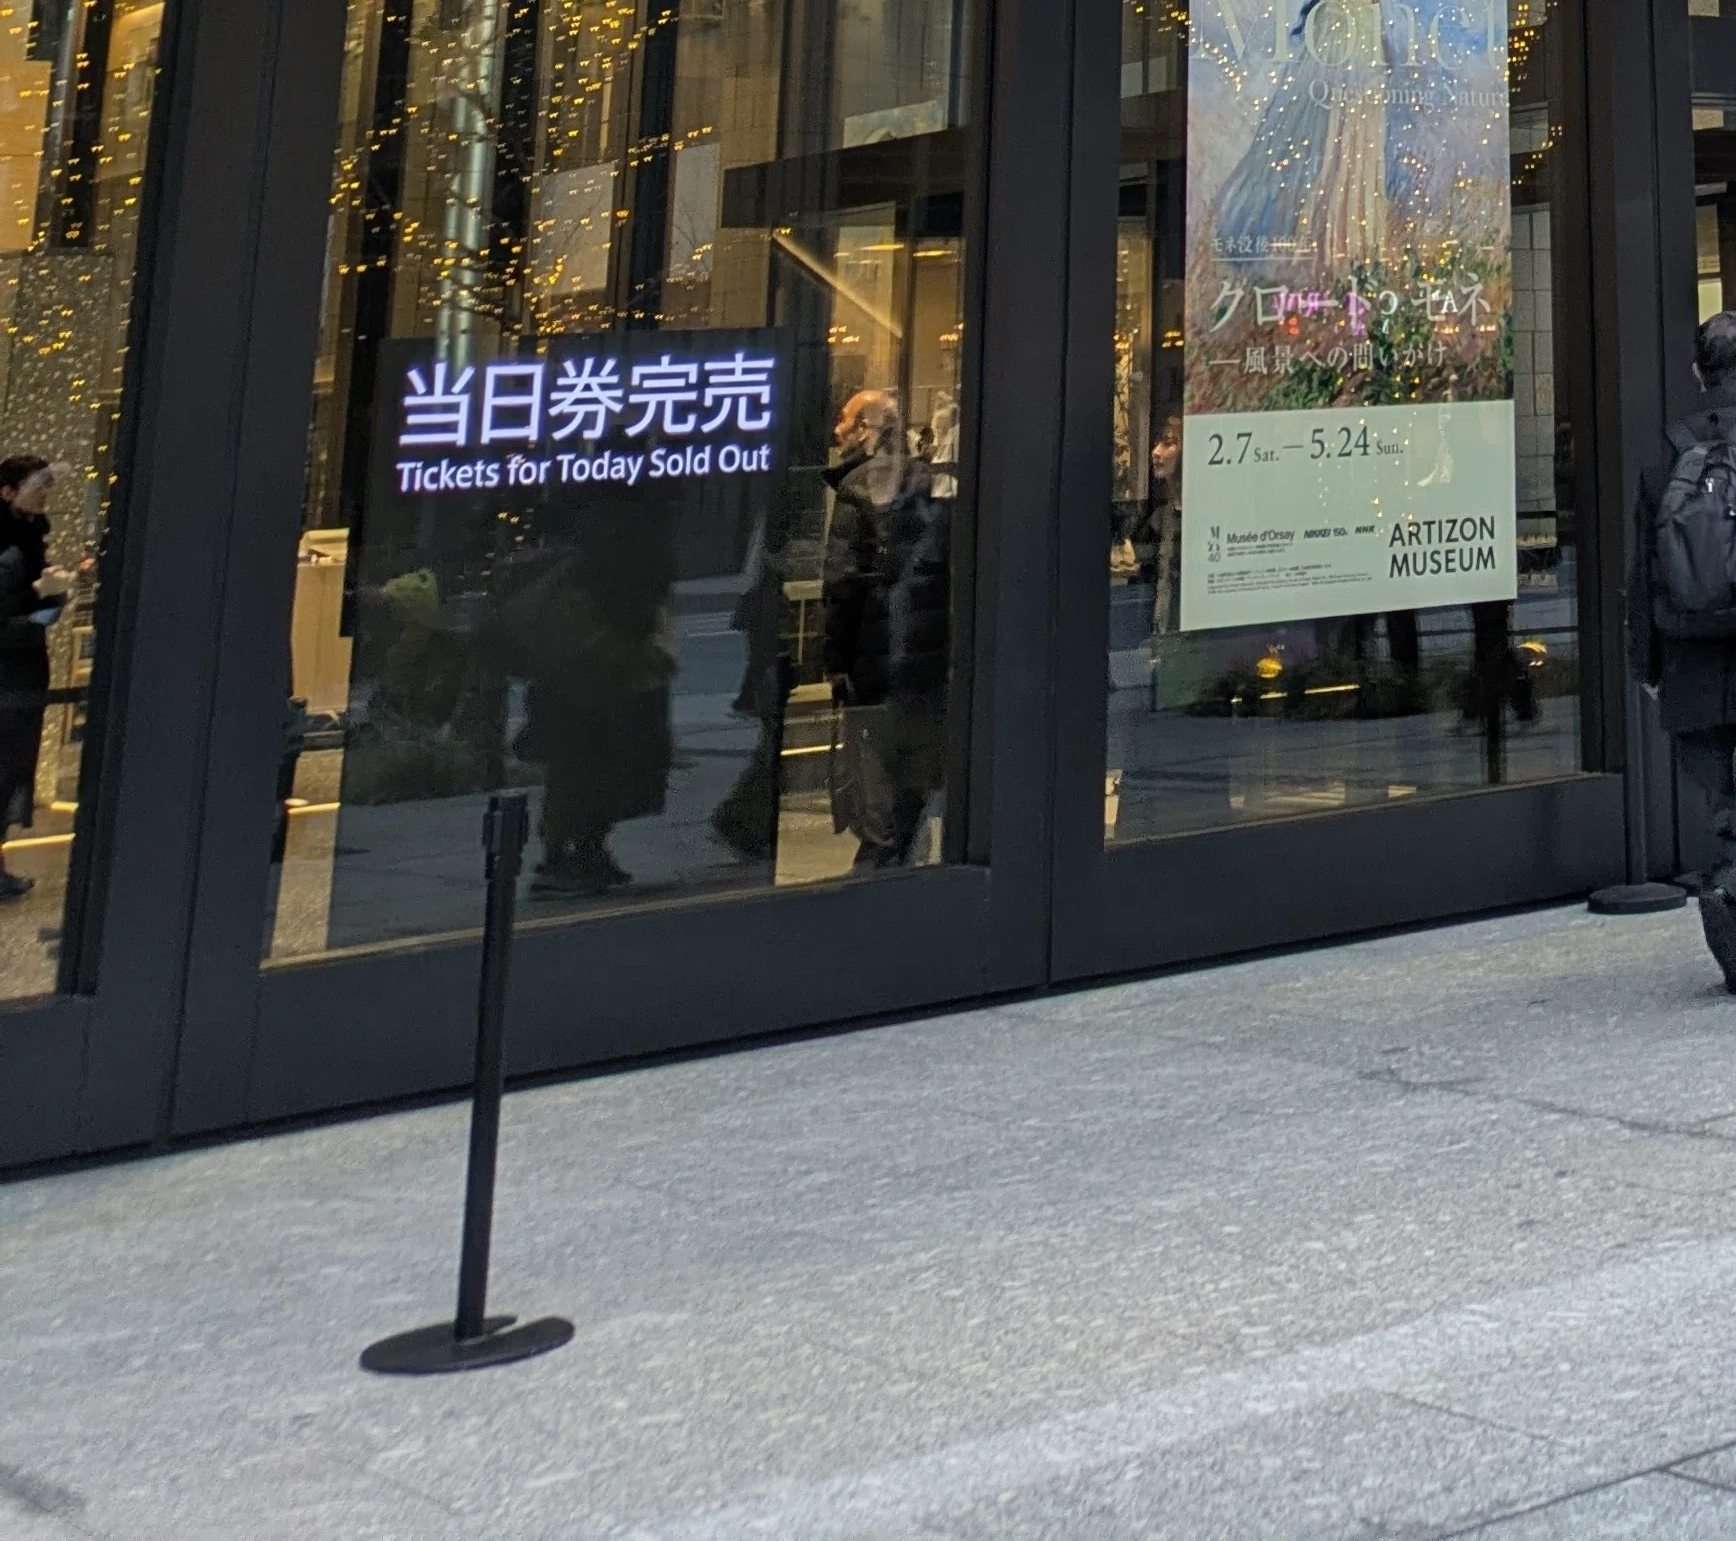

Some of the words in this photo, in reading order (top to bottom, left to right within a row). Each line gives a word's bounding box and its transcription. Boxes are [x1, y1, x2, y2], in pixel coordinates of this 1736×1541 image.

[398, 350, 776, 447] 当日券完売
[1207, 431, 1253, 466] 2.7
[1254, 446, 1280, 463] Sat.
[1309, 425, 1370, 460] 5.24
[1375, 440, 1404, 456] Sun.
[396, 457, 500, 493] Tickets
[507, 454, 551, 487] for
[556, 451, 645, 487] Today
[649, 443, 711, 478] Sold
[718, 442, 771, 474] Out
[1388, 516, 1496, 548] ARTIZON
[1388, 546, 1496, 579] MUSEUM
